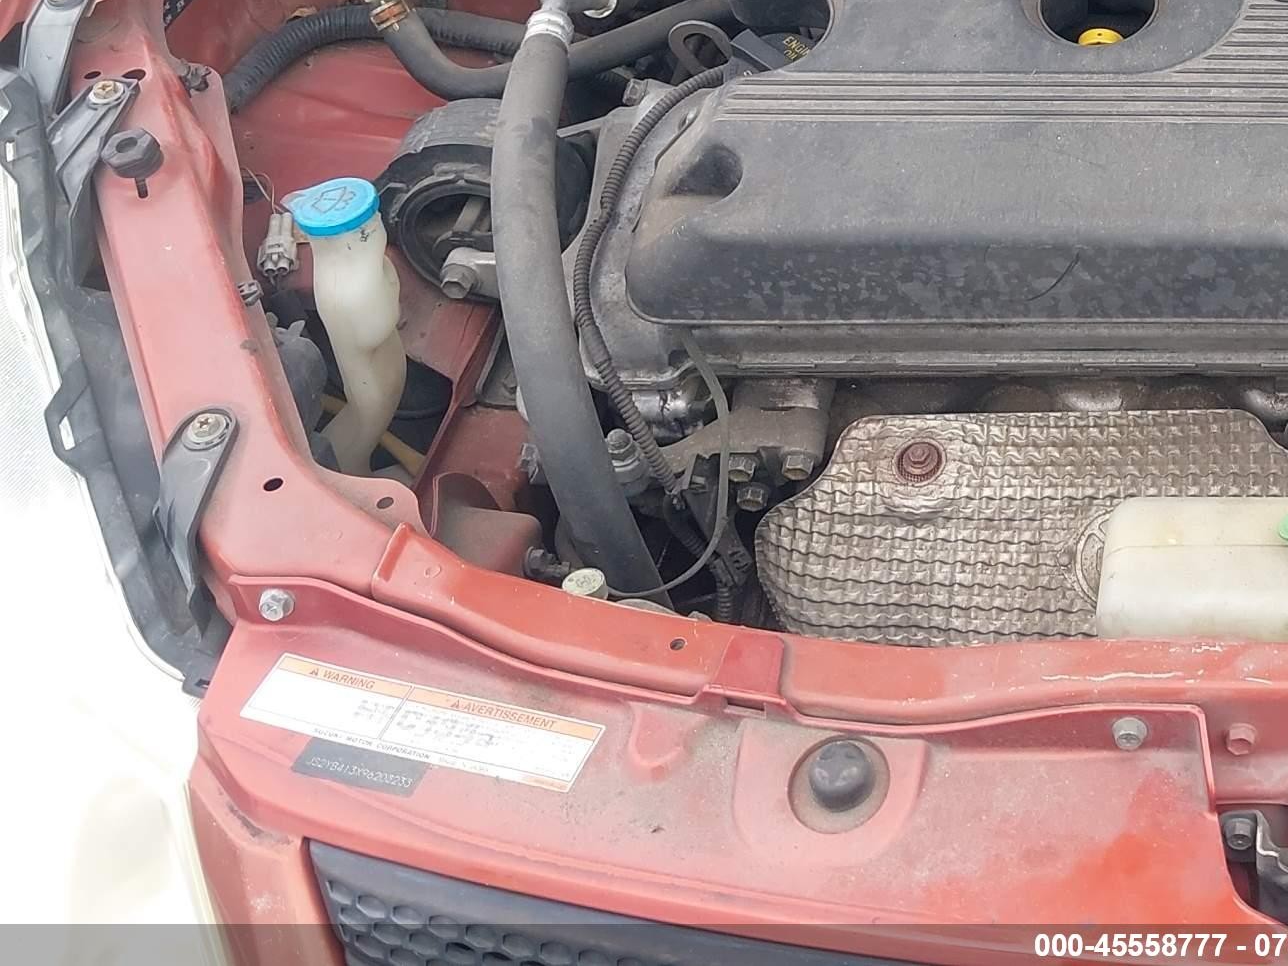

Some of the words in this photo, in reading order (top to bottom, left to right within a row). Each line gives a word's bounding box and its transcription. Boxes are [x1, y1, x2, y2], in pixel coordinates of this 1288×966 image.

[322, 669, 376, 690] WARNING
[460, 701, 558, 730] AVERTISSEMENT
[375, 742, 431, 760] CORPORATION
